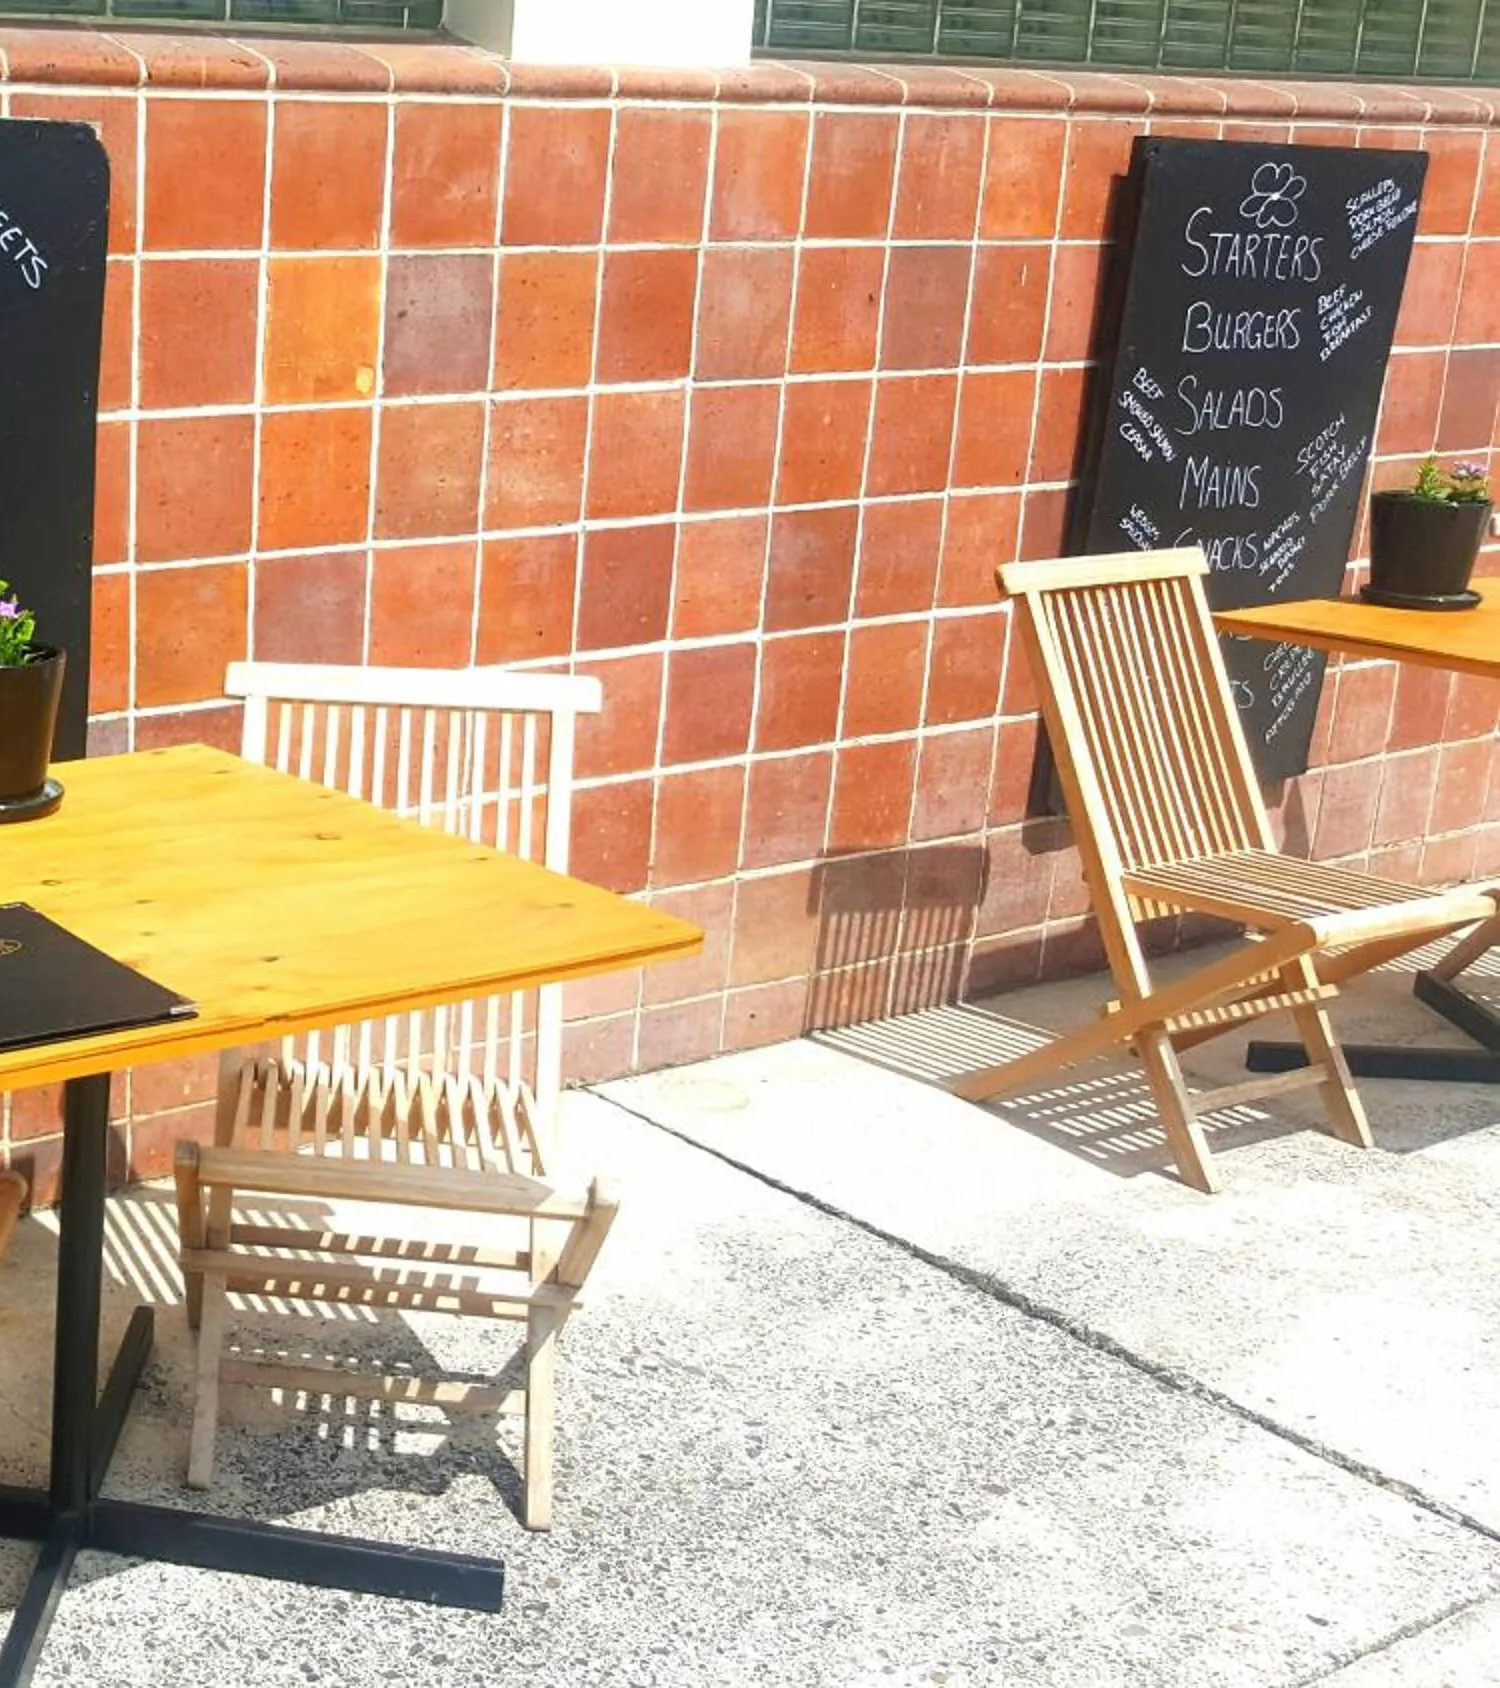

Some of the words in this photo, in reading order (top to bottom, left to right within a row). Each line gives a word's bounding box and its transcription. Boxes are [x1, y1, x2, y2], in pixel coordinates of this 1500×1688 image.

[1181, 207, 1325, 282] STARTERS
[1182, 301, 1302, 353] BURGERS
[1174, 375, 1283, 435] SALADS
